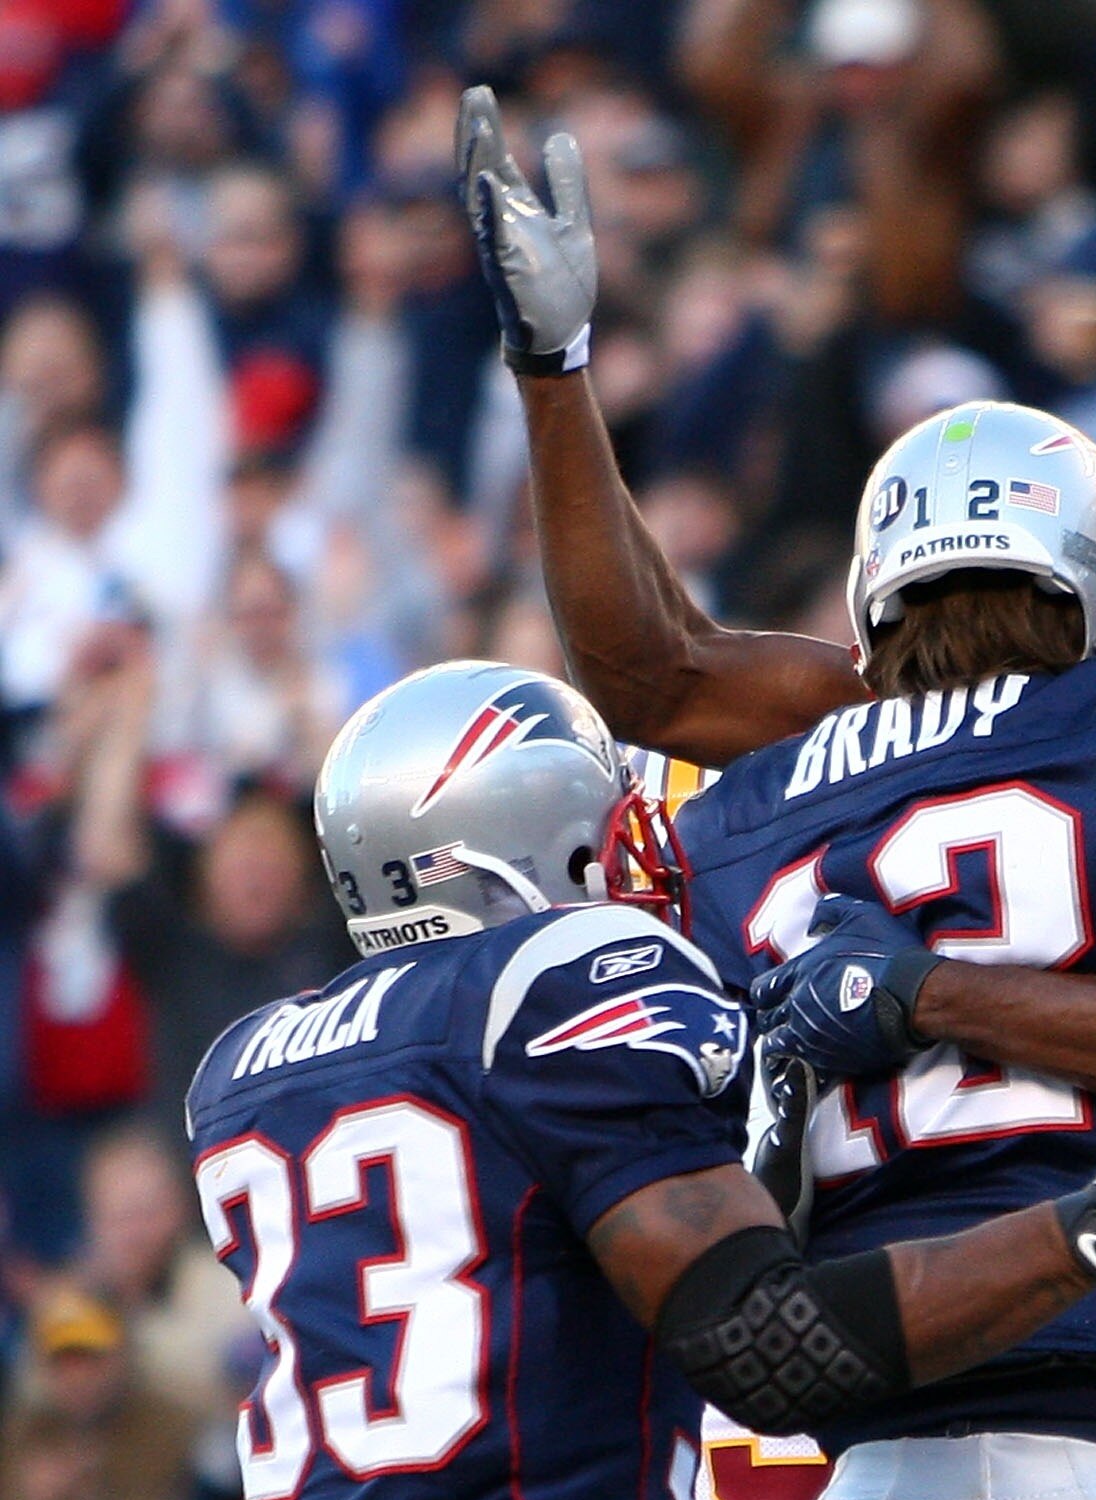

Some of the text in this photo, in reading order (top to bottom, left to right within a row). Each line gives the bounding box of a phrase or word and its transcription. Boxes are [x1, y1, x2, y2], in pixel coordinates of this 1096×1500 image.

[900, 533, 1011, 566] PATRIOTS
[785, 674, 1030, 800] BRADY
[353, 914, 449, 950] PATRIOTS
[231, 960, 418, 1081] FAULK
